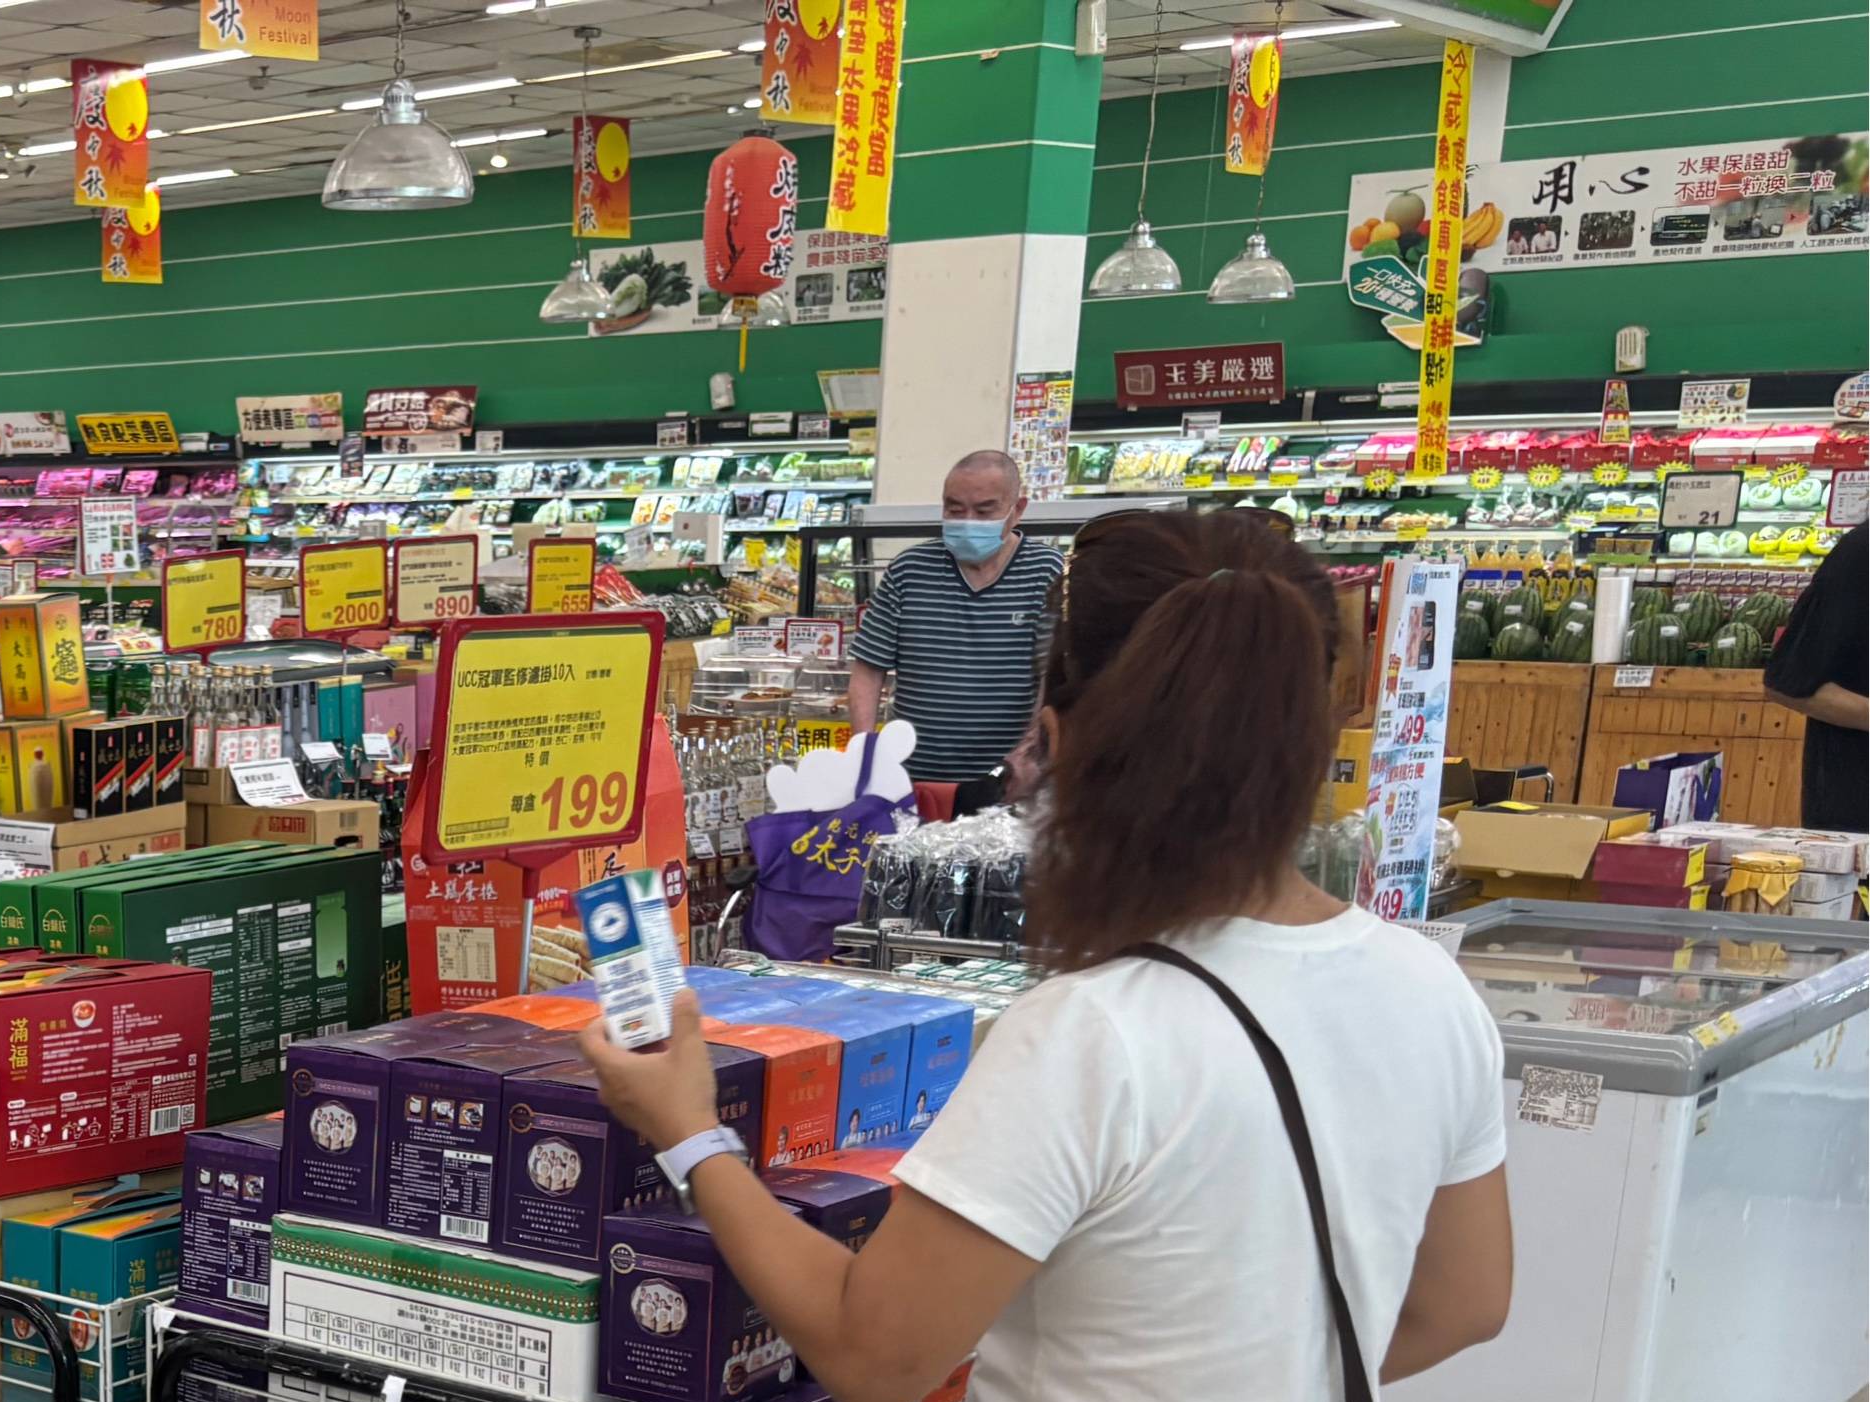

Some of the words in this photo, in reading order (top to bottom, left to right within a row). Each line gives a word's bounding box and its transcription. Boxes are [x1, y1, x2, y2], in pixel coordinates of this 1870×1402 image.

[275, 6, 311, 24] Moon
[258, 24, 313, 46] Festival
[76, 66, 107, 199] 慶中秋
[1678, 150, 1791, 175] 水果保證甜
[1532, 160, 1650, 213] 用心
[1674, 169, 1836, 201] 不甜一粒換二粒
[1163, 356, 1275, 386] 玉美嚴選
[1698, 511, 1721, 525] 21
[333, 602, 380, 625] 2000
[434, 596, 470, 617] 890
[561, 594, 589, 612] 655
[202, 615, 238, 641] 780
[541, 771, 629, 832] 199
[9, 1017, 29, 1069] 滿福
